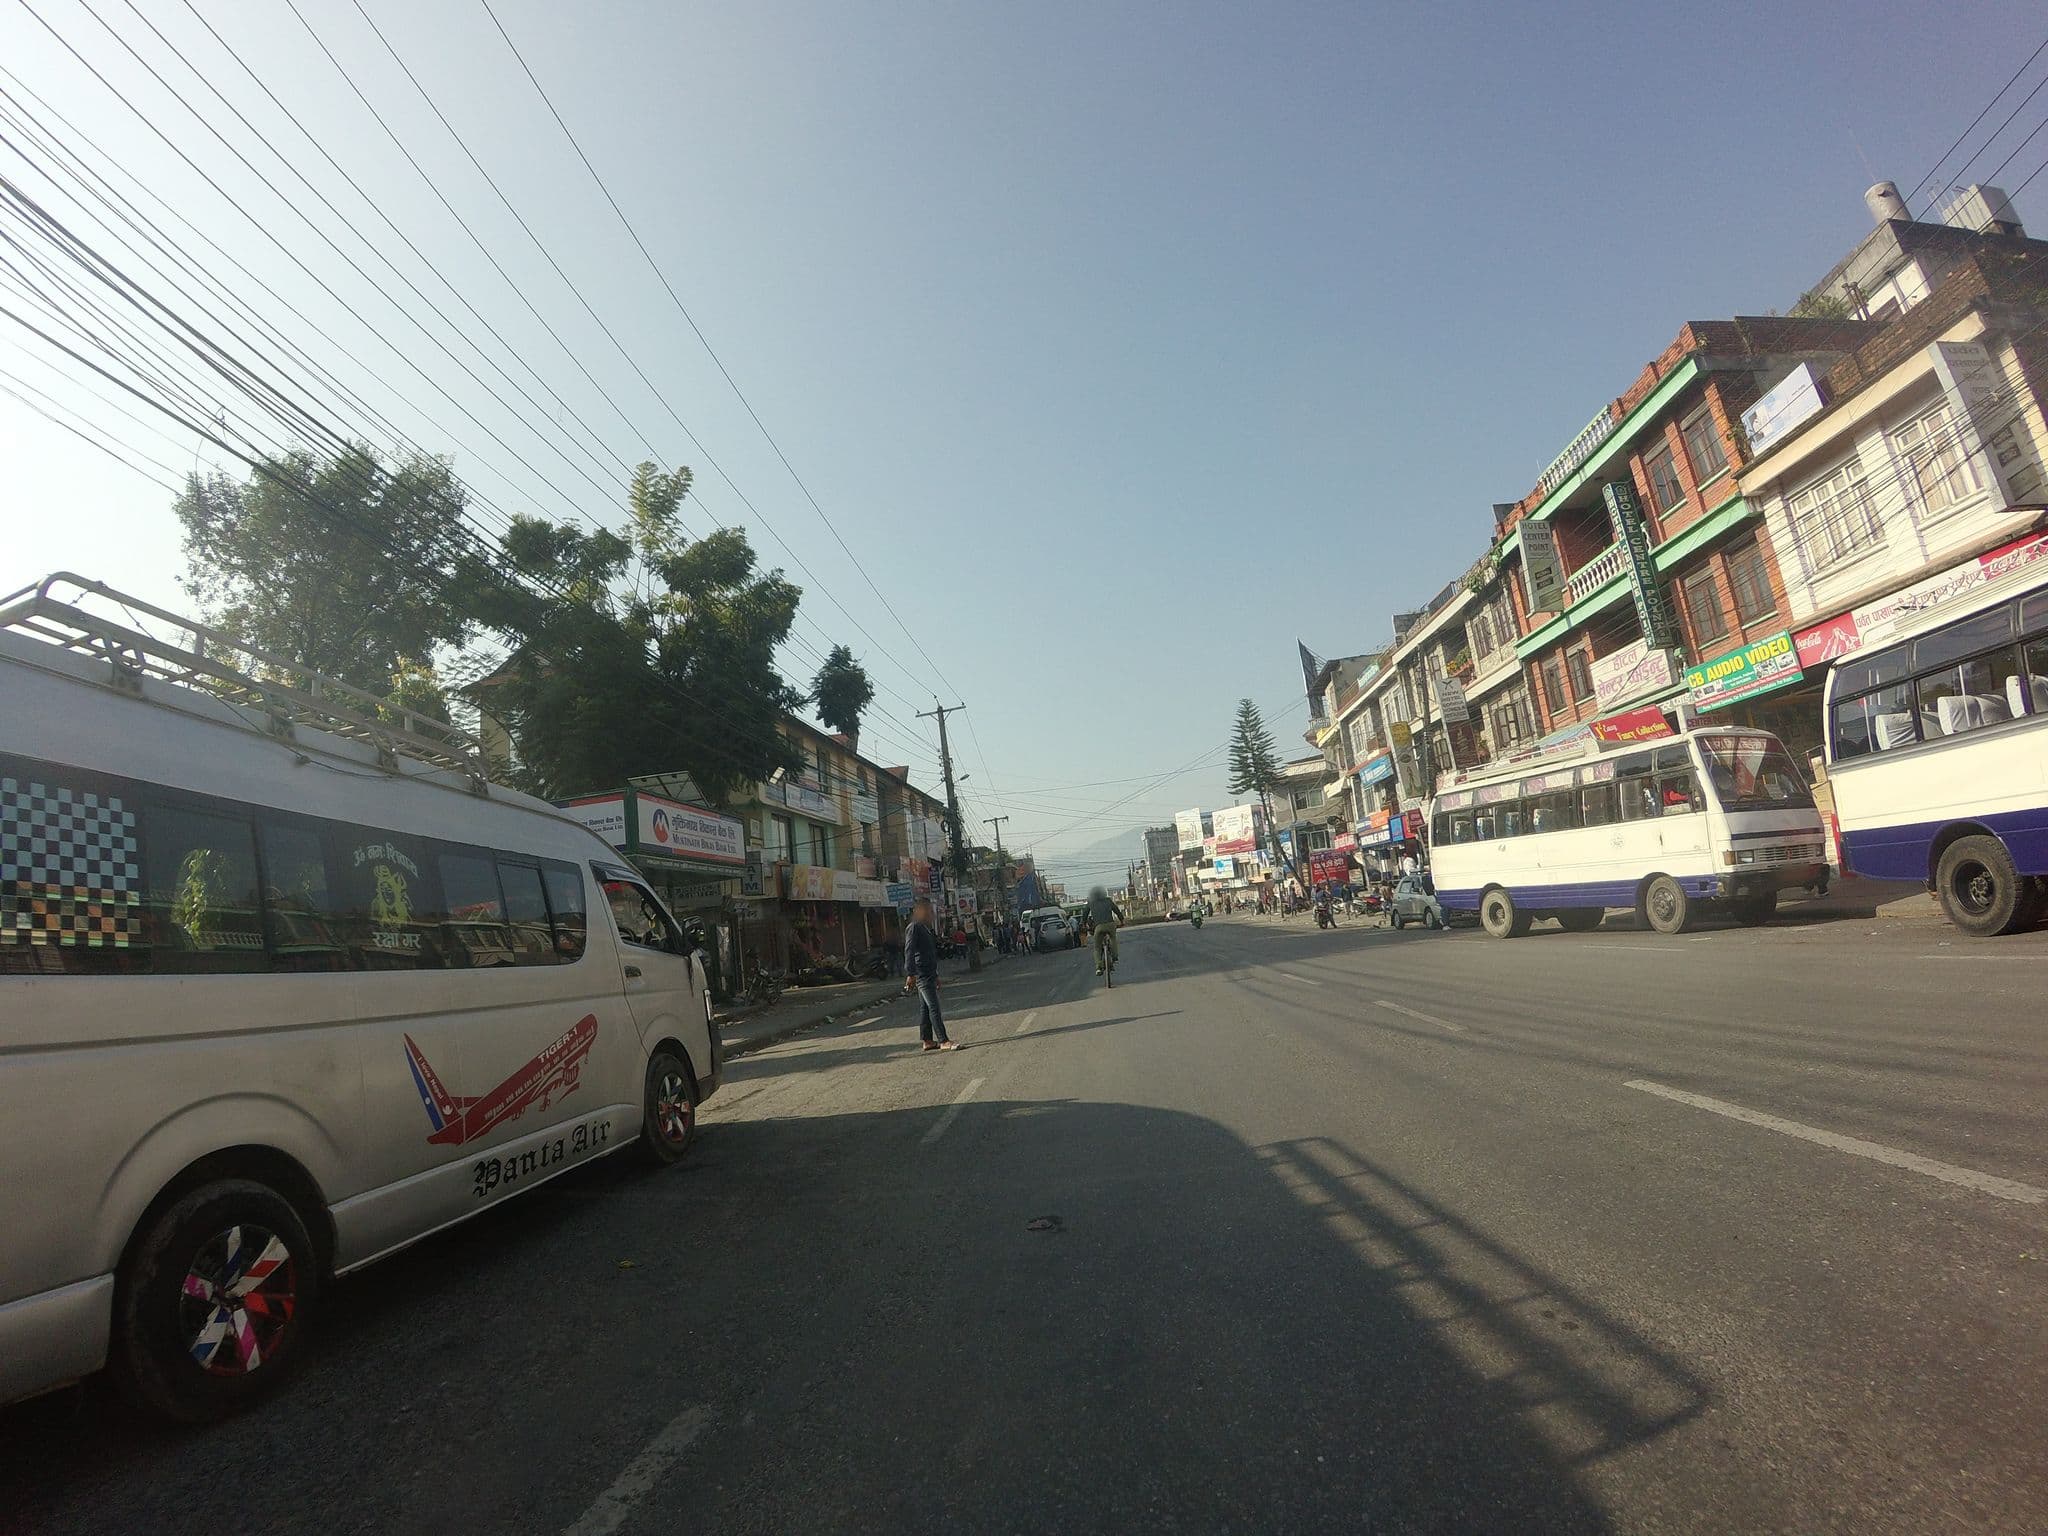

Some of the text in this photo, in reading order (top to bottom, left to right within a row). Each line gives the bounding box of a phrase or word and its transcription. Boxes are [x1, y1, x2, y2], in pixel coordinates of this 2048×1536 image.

[1522, 522, 1548, 530] HOTEL
[1523, 532, 1550, 541] CENTER
[1618, 494, 1638, 534] HOTEL
[1631, 537, 1653, 586] CENTRE
[1528, 543, 1549, 551] POINT
[1607, 499, 1624, 540] HOTEL
[1622, 544, 1639, 598] CENTRE
[1687, 671, 1705, 688] CB
[1706, 655, 1745, 682] AUDIO
[1745, 637, 1790, 665] VIDEO
[372, 931, 400, 949] रक्षा
[537, 1026, 579, 1063] TIGER-1
[472, 1120, 612, 1198] Panta Air
